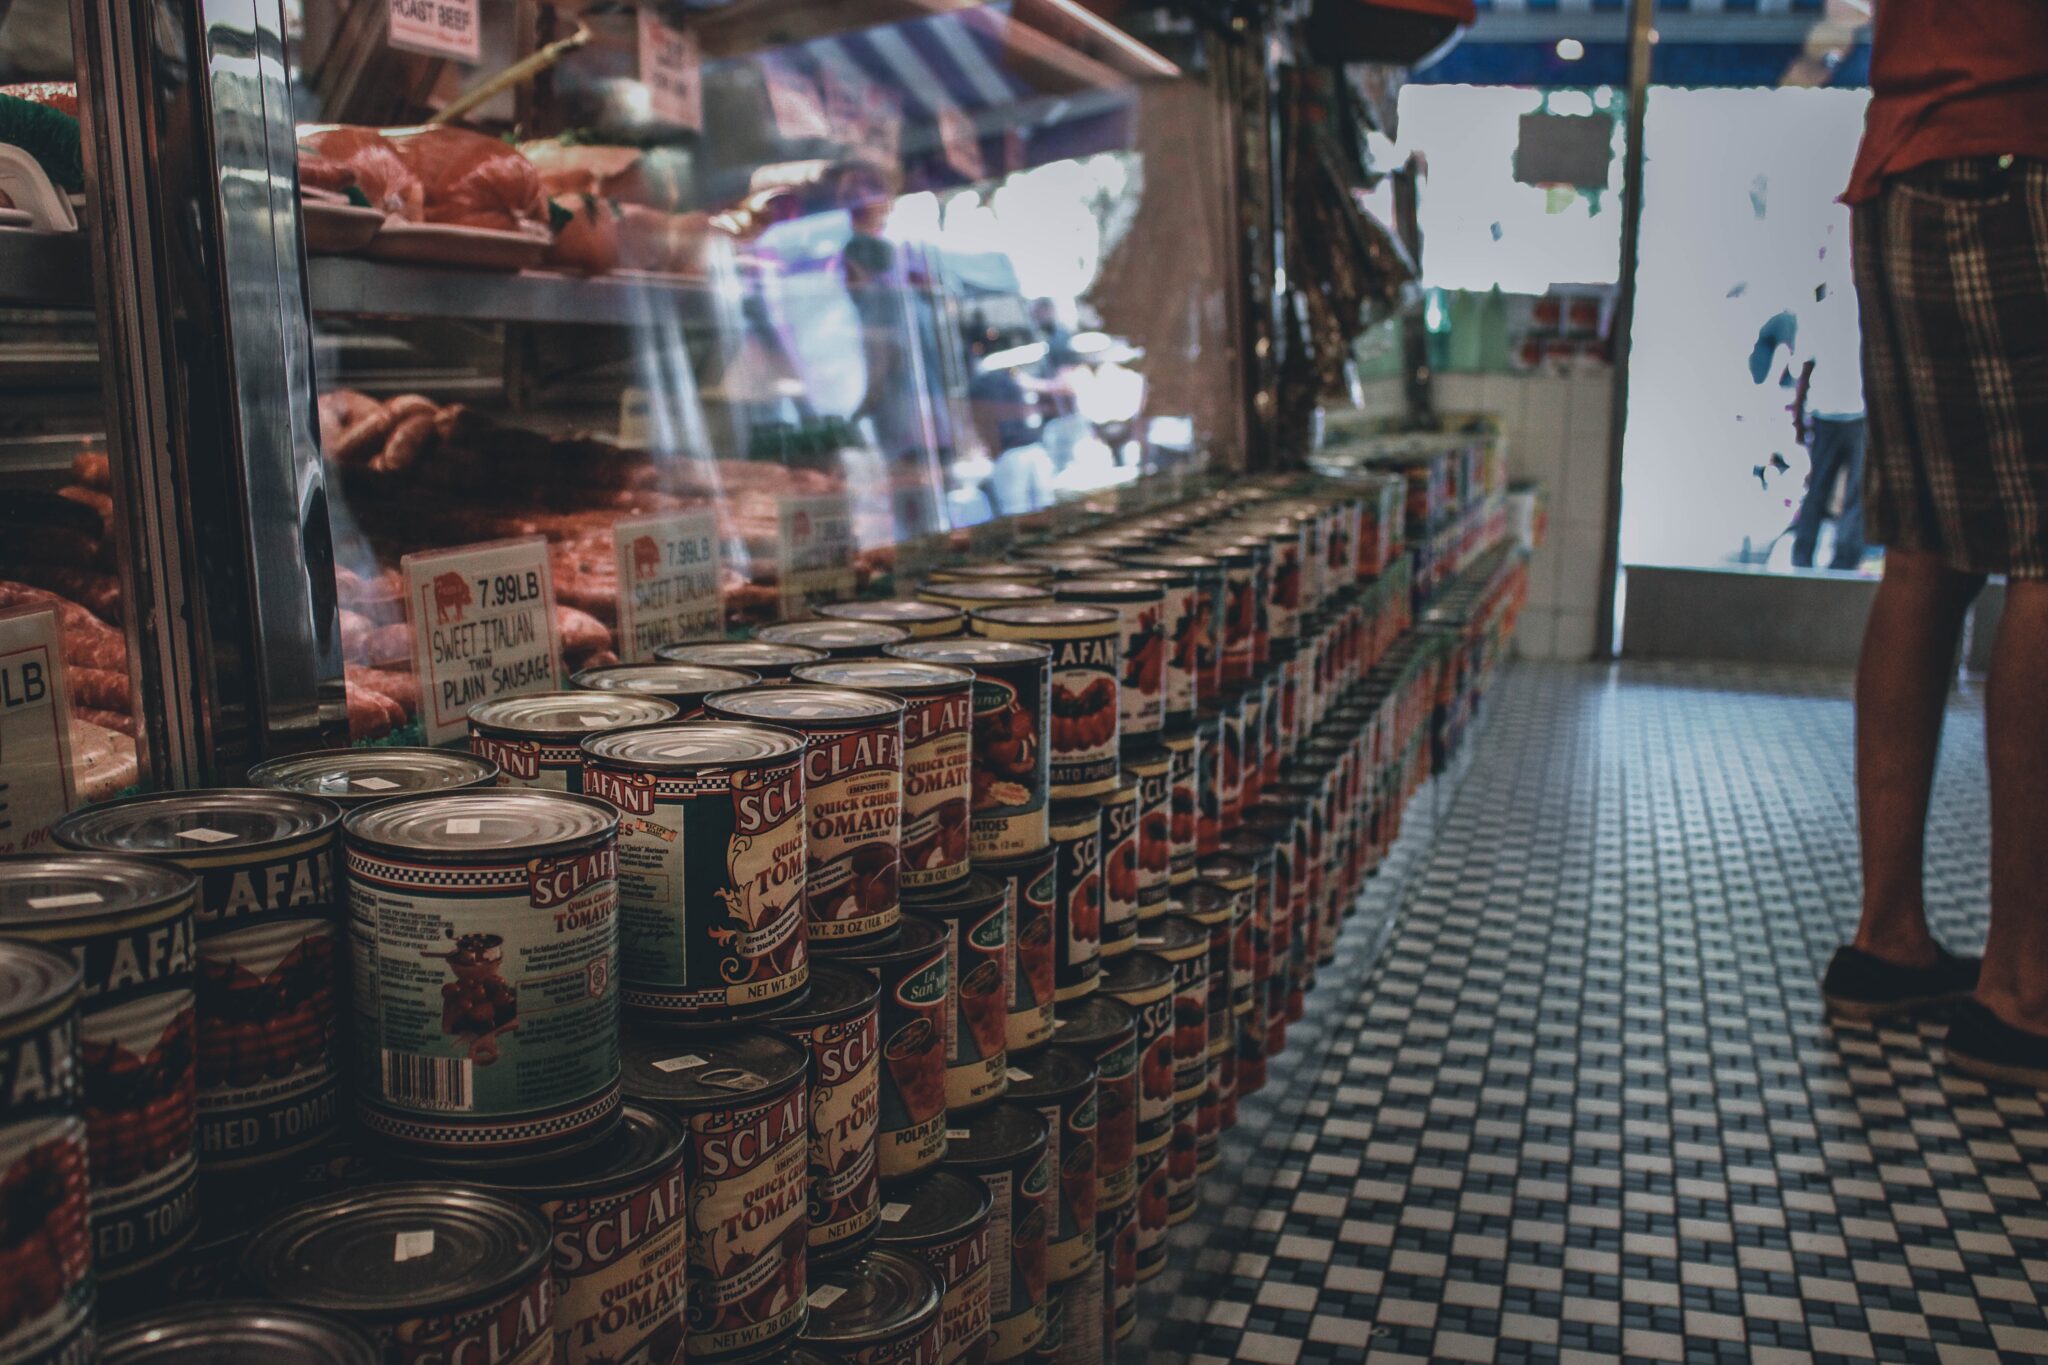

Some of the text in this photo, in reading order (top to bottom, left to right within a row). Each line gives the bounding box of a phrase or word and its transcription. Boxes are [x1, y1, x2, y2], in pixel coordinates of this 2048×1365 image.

[438, 5, 470, 31] BEEF
[478, 571, 540, 609] 7.99LB
[433, 611, 535, 664] SWEET ITALIAN
[468, 656, 493, 671] THIN
[443, 654, 551, 710] PLAIN SAUSAGE
[907, 758, 945, 777] QUICK
[813, 796, 860, 819] QUICK
[843, 834, 861, 844] WITH
[745, 933, 767, 945] Great
[808, 925, 830, 937] WT.
[832, 923, 845, 935] 28
[847, 921, 864, 933] OZ
[747, 984, 769, 999] NET
[771, 979, 788, 993] WT.
[910, 983, 934, 1000] San
[203, 1117, 260, 1152] HED
[895, 1124, 930, 1146] POLPA
[743, 1172, 786, 1209] QUICK
[827, 1223, 848, 1239] NET
[601, 1267, 655, 1308] QUICK
[712, 1333, 738, 1349] NET
[741, 1326, 763, 1343] WT.
[766, 1320, 778, 1334] 28
